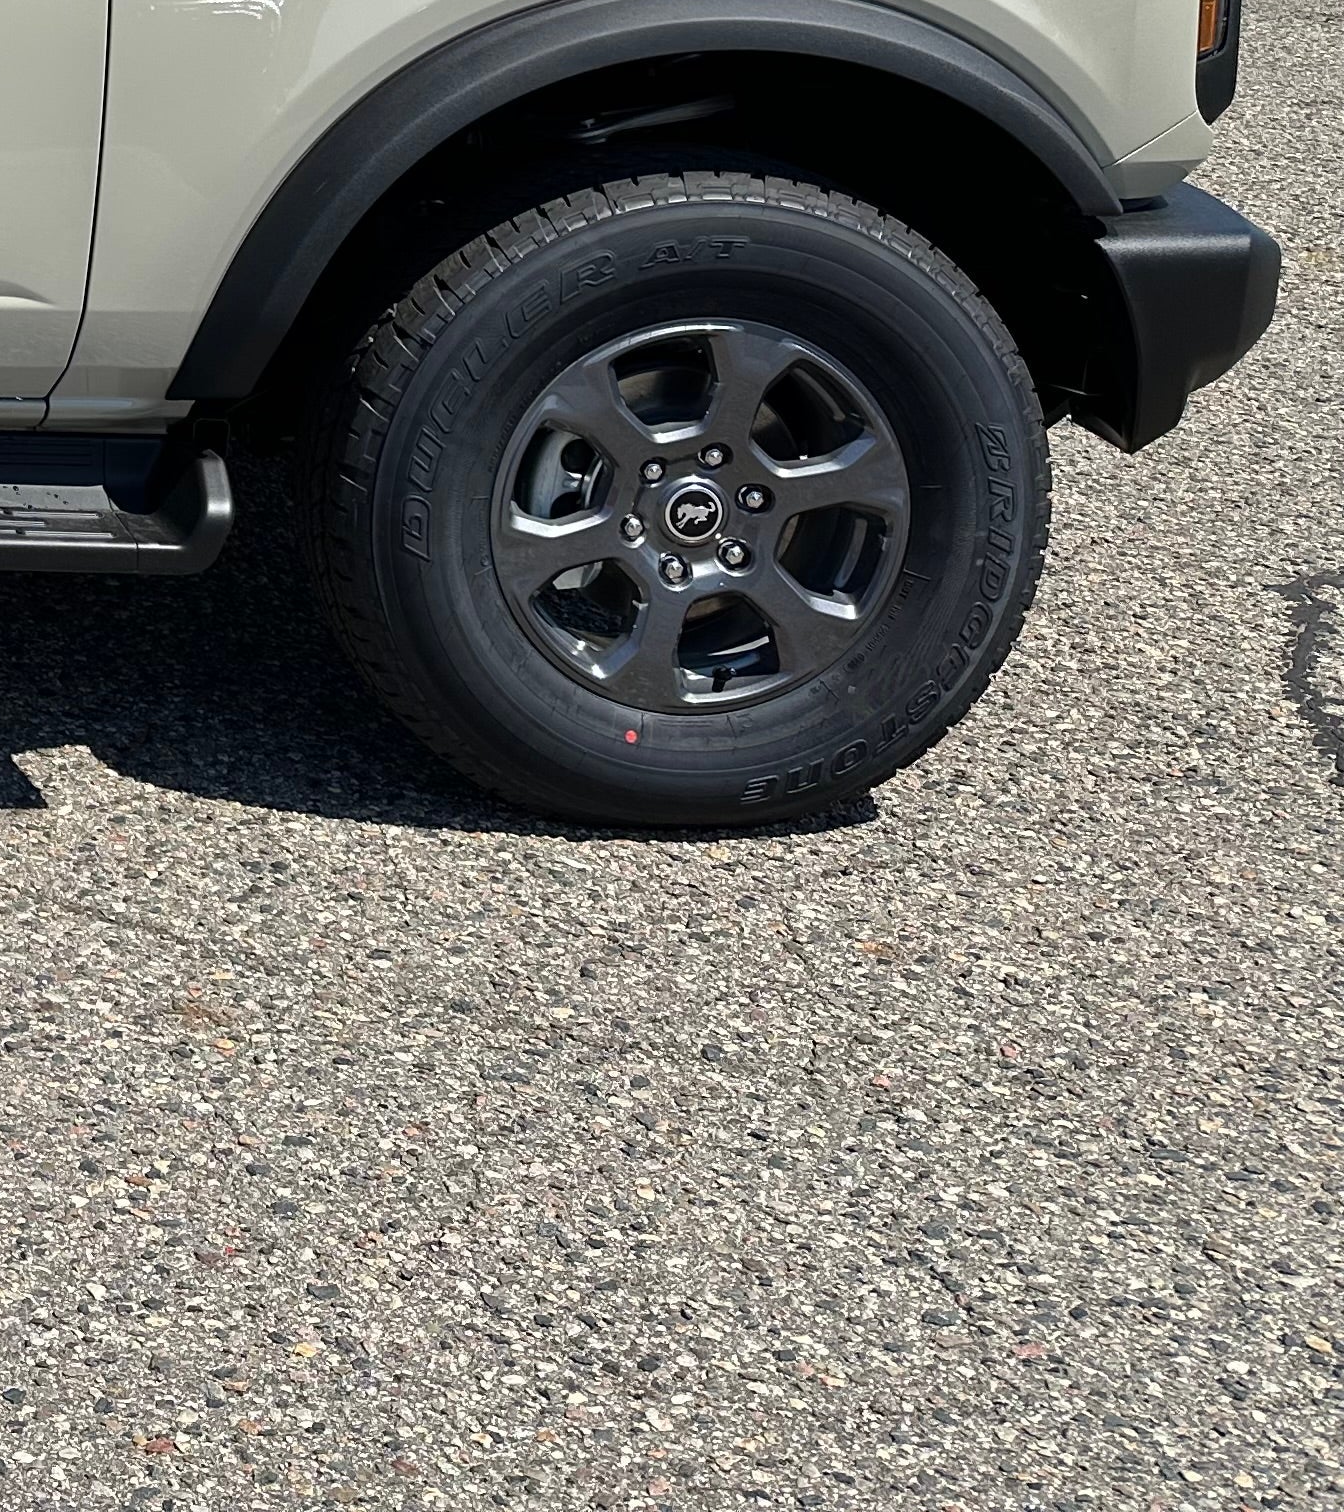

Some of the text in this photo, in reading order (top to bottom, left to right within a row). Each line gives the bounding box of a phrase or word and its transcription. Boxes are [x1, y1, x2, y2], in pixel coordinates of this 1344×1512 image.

[401, 234, 753, 565] DUELER A/T
[739, 422, 1018, 807] BRIDGESTONE
